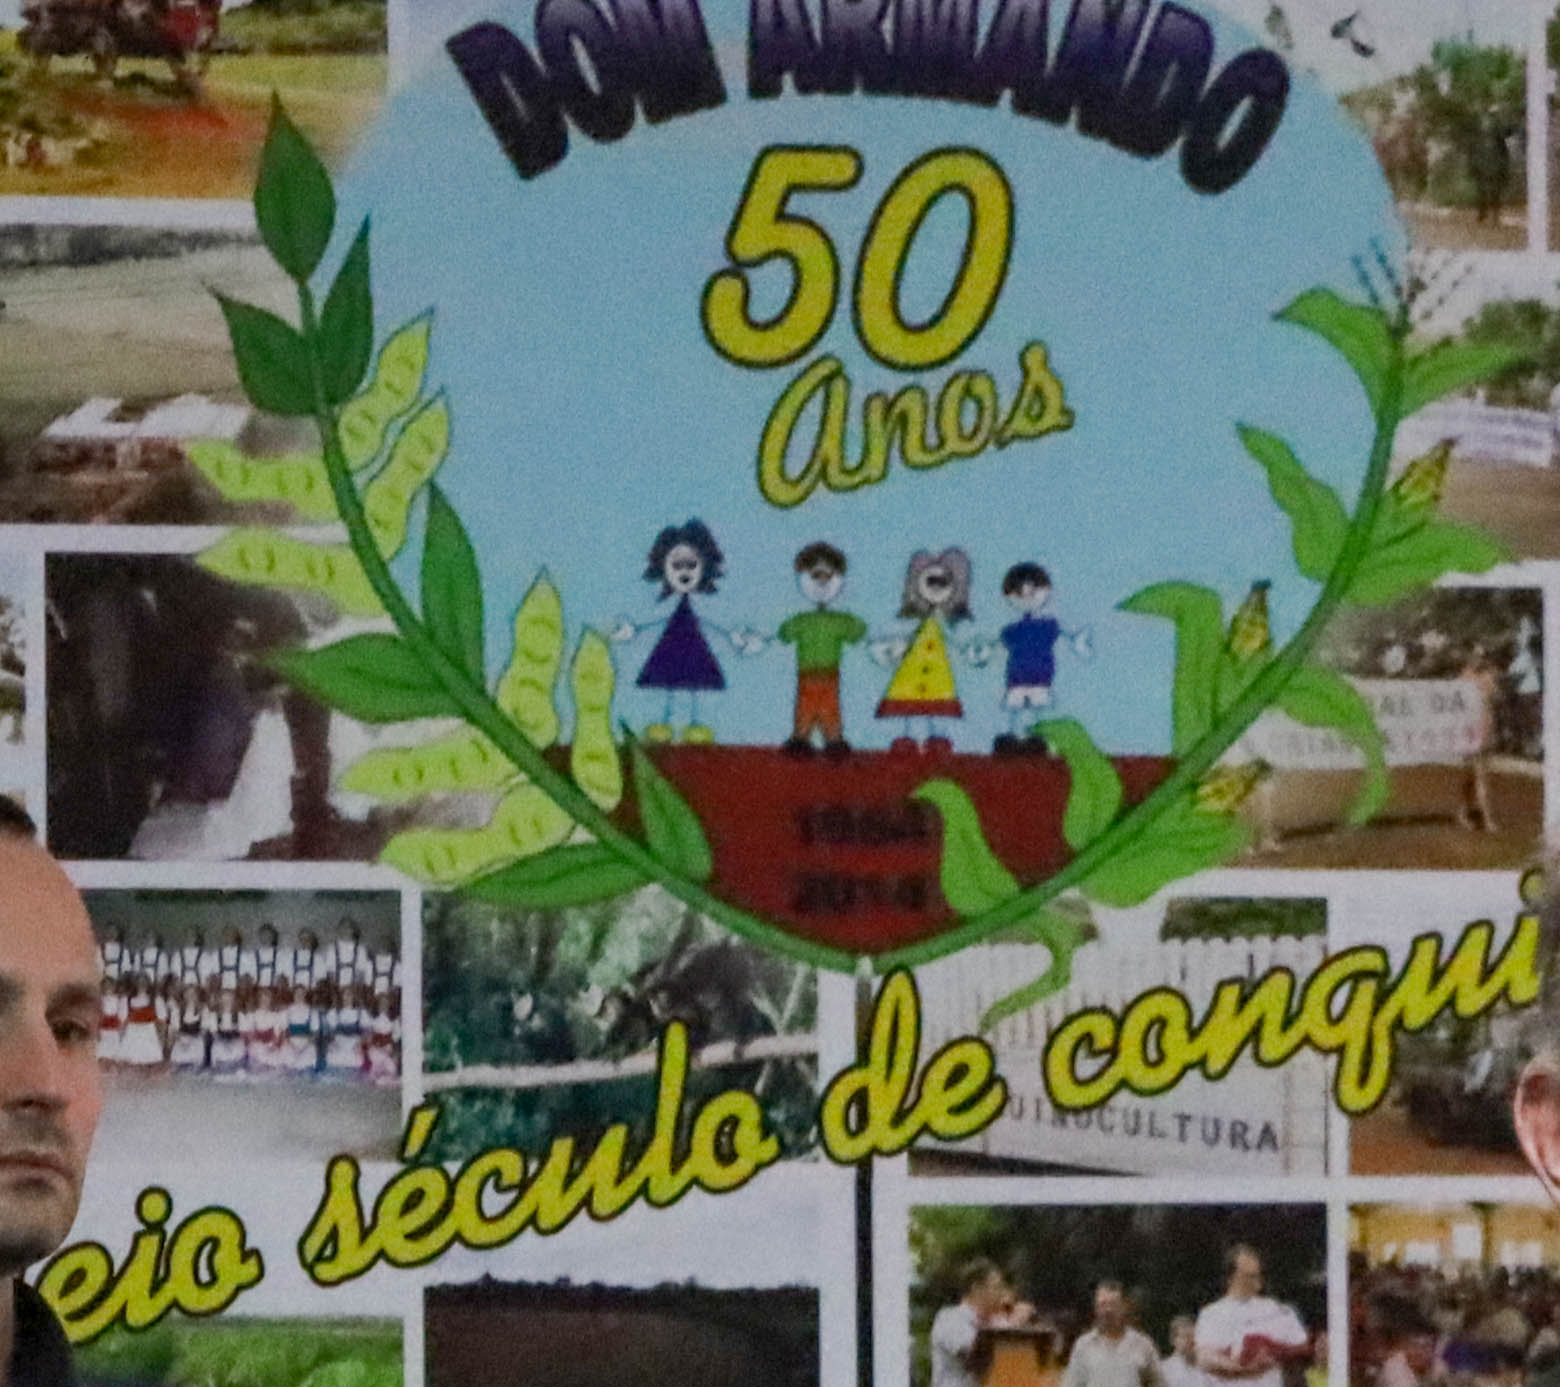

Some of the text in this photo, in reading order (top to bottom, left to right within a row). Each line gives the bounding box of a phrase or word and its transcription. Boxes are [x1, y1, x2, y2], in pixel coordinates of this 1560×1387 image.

[445, 0, 1292, 195] DOM ARMANDO
[699, 144, 1017, 370] 50
[757, 339, 1075, 508] Anos
[37, 867, 1542, 1344] eio século de conqui
[1007, 1095, 1281, 1153] UINOCULTURA
